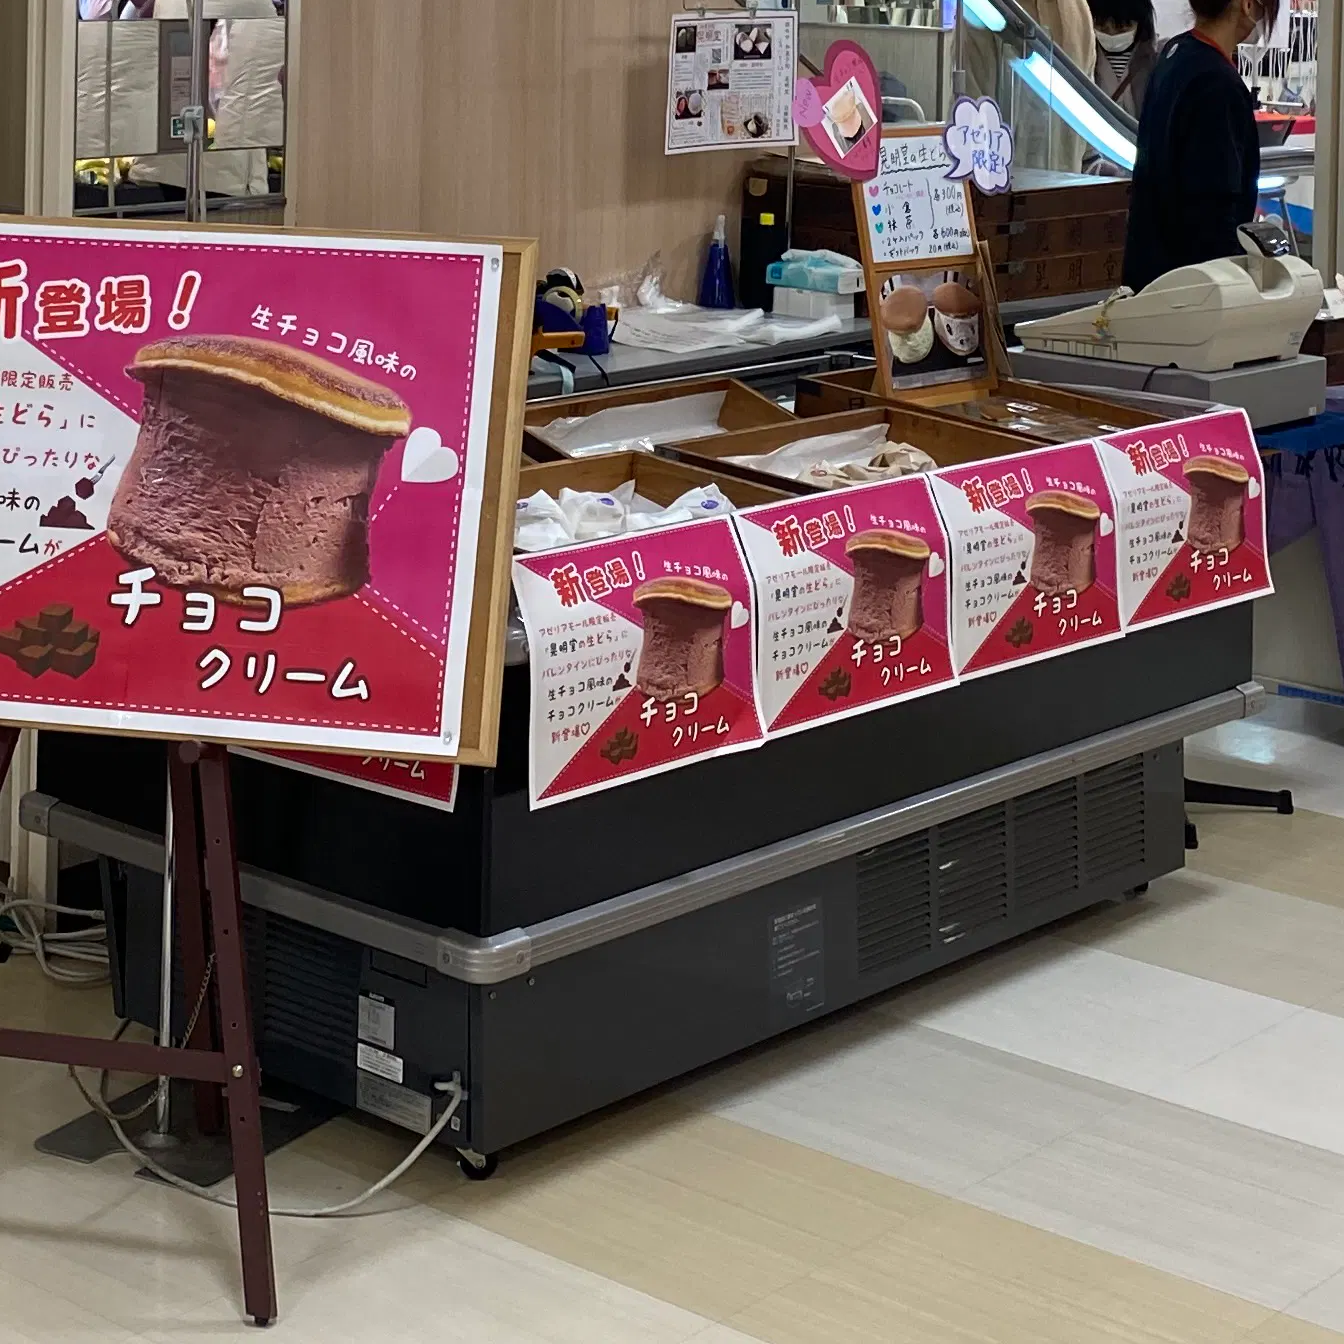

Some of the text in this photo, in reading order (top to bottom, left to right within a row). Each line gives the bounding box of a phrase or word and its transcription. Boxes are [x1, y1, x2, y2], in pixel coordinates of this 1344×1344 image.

[957, 123, 1004, 153] アゼリア
[971, 149, 1006, 175] 限定!
[250, 305, 418, 383] 生チョコ風味の
[771, 505, 856, 558] 新登場！
[663, 560, 729, 582] 生チョコ風味の
[1190, 547, 1229, 574] チョコ
[549, 550, 645, 607] 新登場！
[1212, 568, 1253, 591] クリーム
[108, 567, 284, 636] チョコ
[1033, 588, 1078, 618] チョコ
[1058, 610, 1102, 637] クリーム
[851, 635, 902, 668] チョコ
[198, 648, 372, 703] クリーム
[880, 657, 932, 687] クリーム
[548, 676, 613, 701] 生チョコ風味の
[640, 692, 699, 728] チョコ
[672, 716, 730, 748] クリーム
